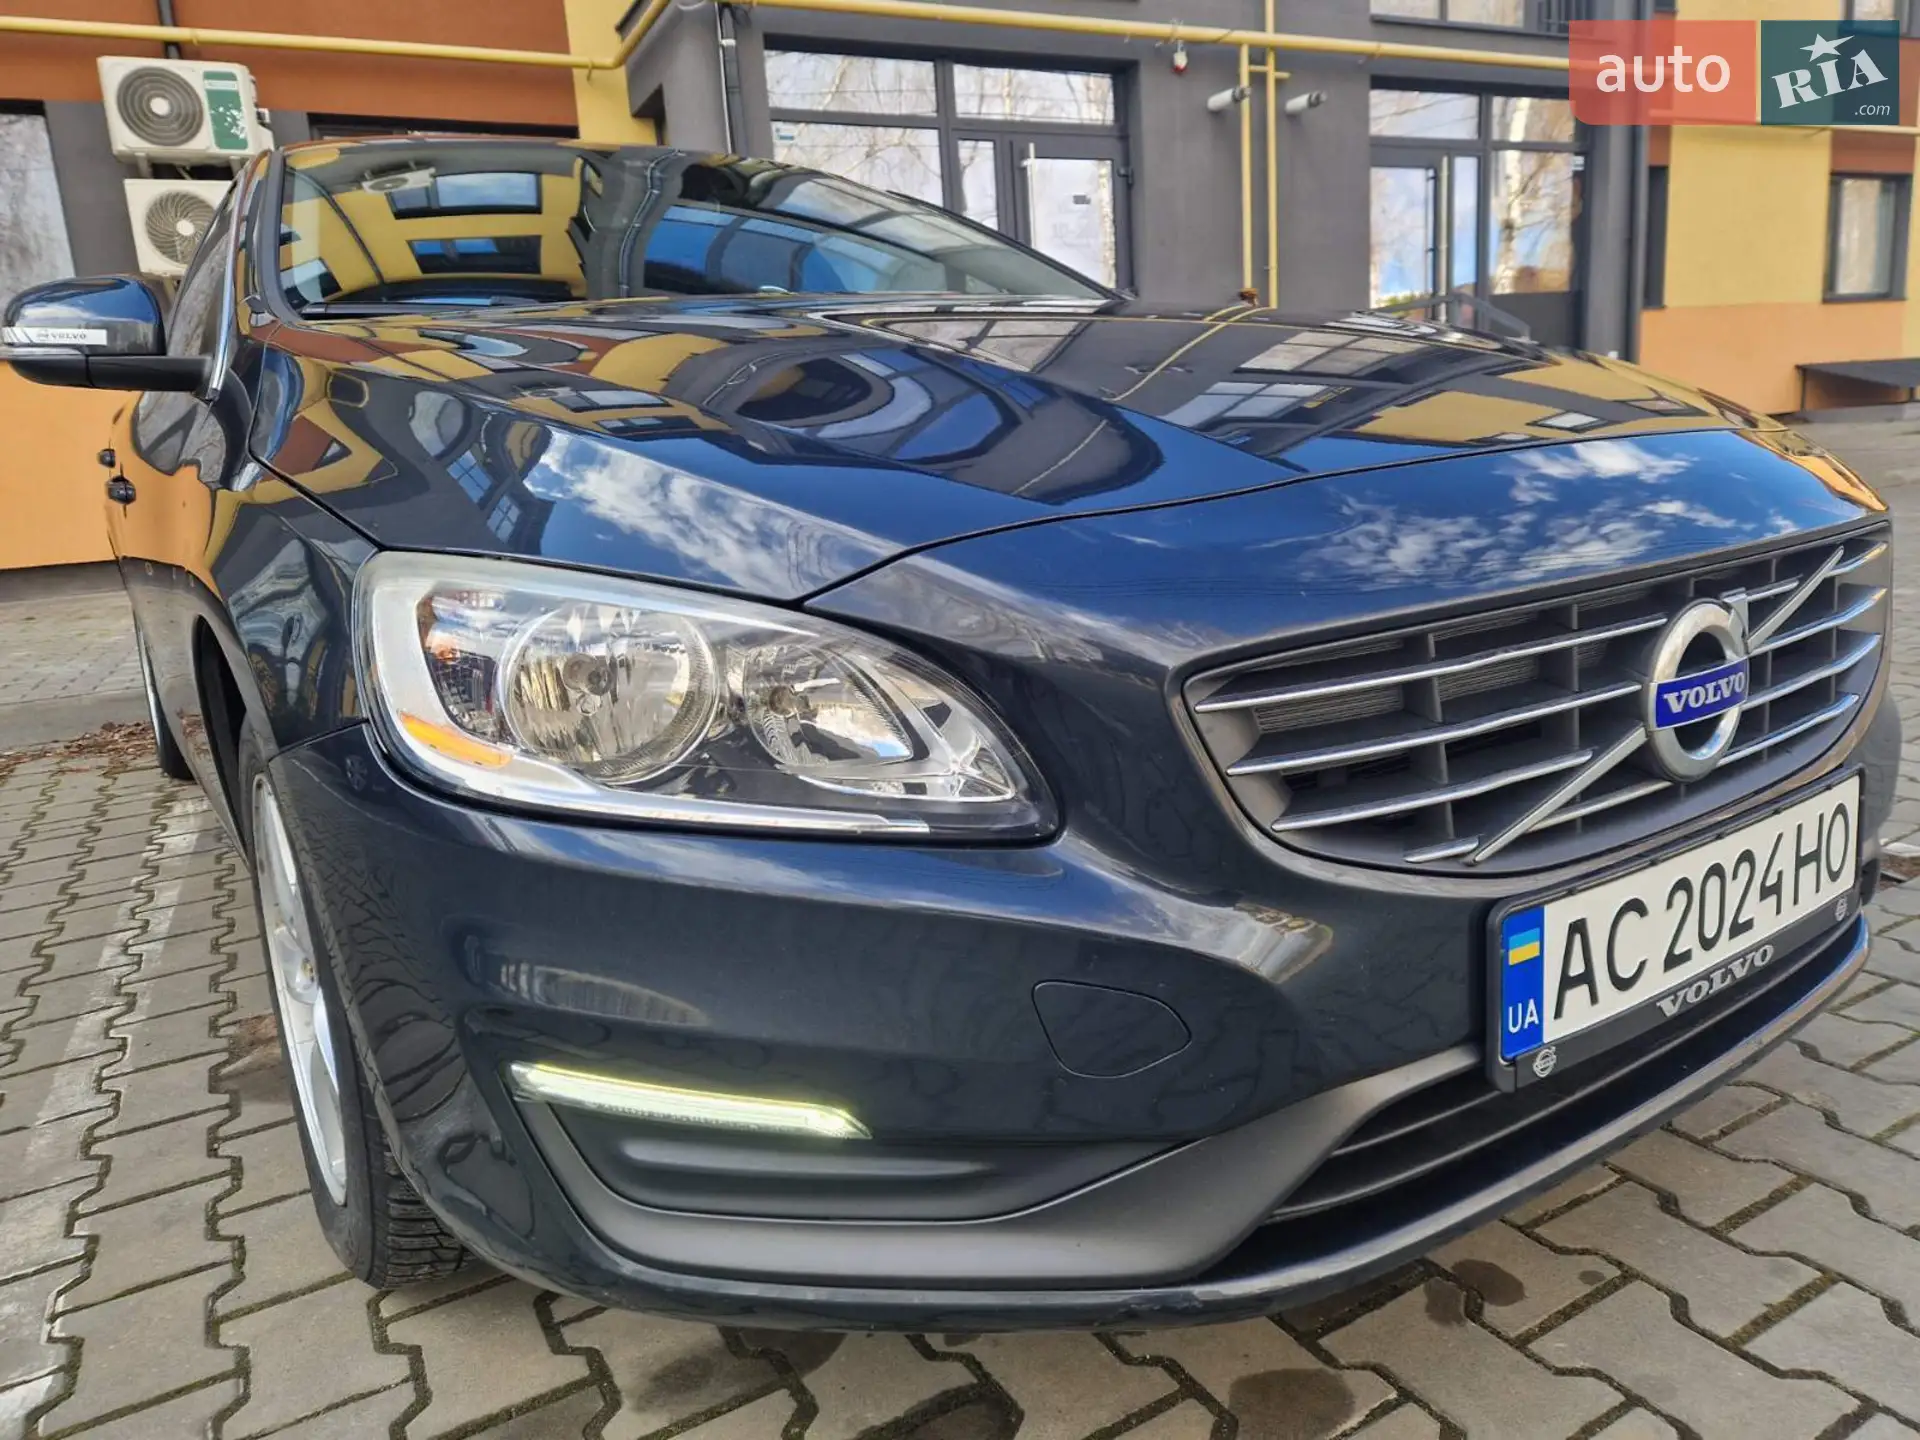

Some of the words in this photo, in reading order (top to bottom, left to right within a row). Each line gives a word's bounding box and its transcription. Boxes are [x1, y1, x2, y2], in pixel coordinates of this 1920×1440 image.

[1664, 671, 1745, 714] VOLVO
[1662, 832, 1784, 973] 2024
[1656, 944, 1774, 1018] VOLVO
[1508, 998, 1539, 1034] UA
